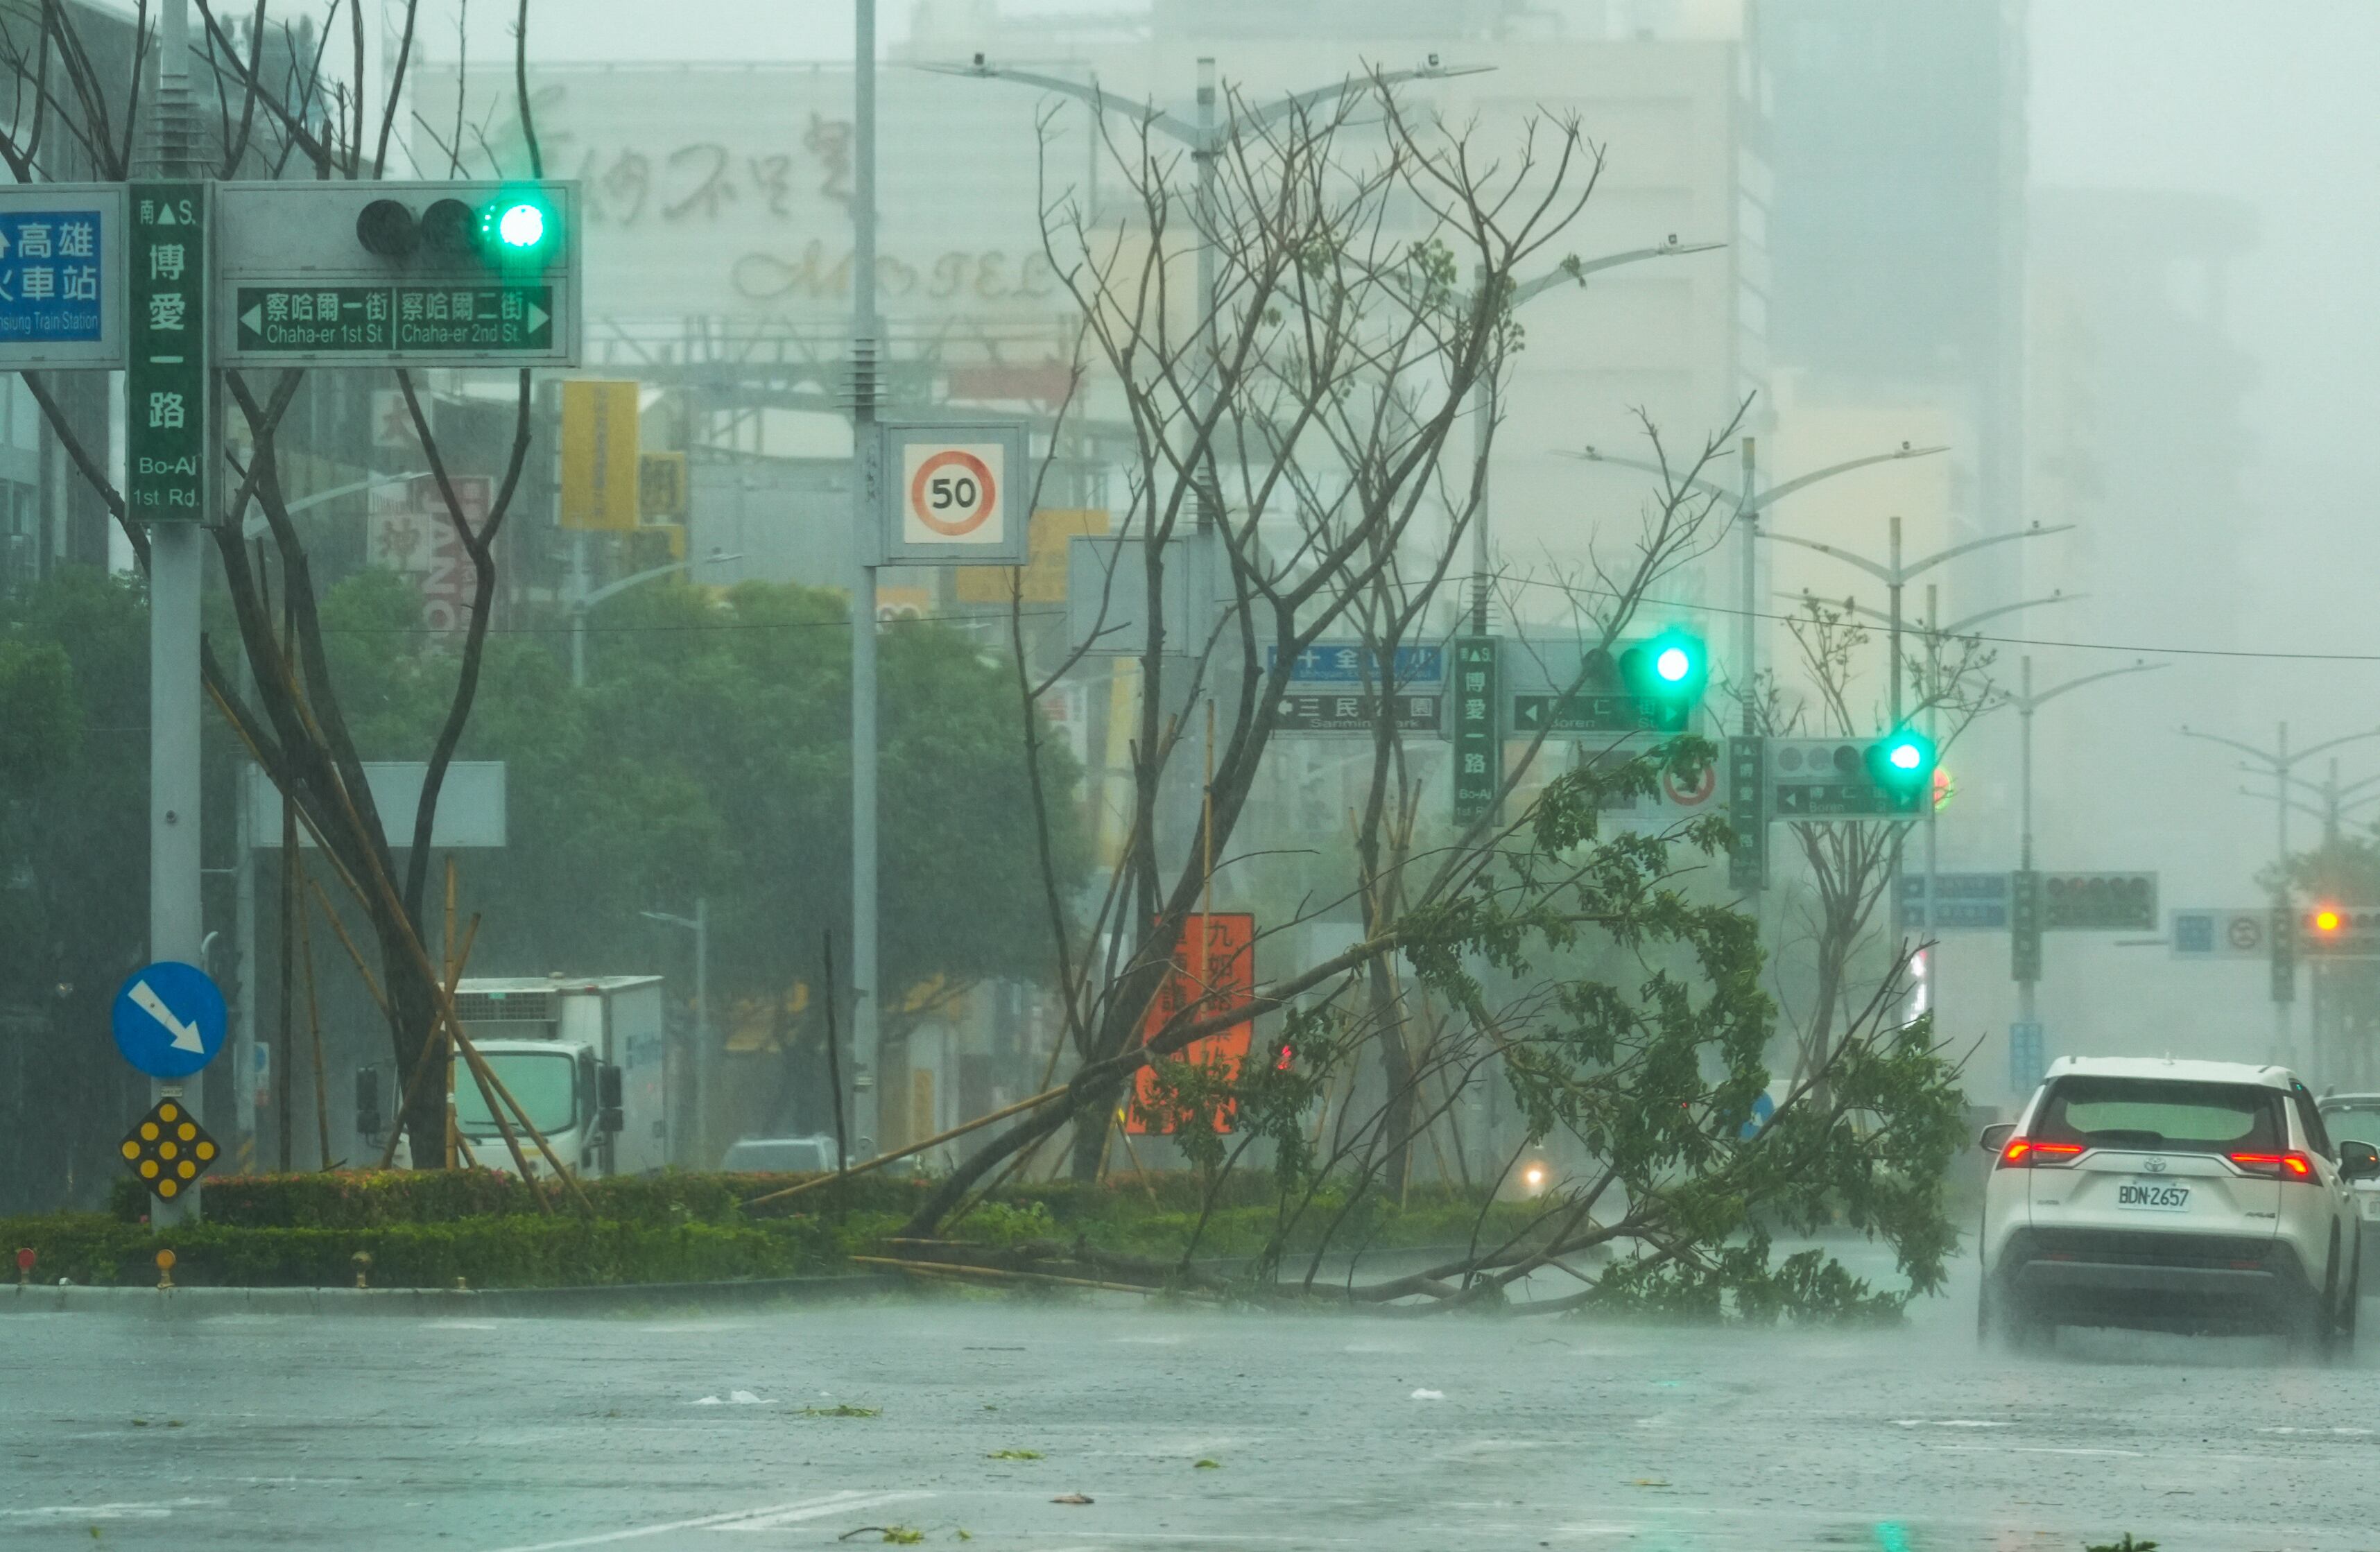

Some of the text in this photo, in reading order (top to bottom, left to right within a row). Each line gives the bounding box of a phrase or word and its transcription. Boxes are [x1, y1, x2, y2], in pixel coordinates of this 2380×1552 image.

[140, 200, 154, 225] 南
[17, 223, 94, 259] 高雄
[266, 292, 388, 322] 察哈爾一街
[402, 291, 523, 321] 察哈爾二街
[33, 311, 60, 329] Train
[62, 311, 98, 330] Station
[402, 323, 468, 343] Chaha-er
[471, 323, 498, 343] 2nd
[149, 244, 186, 429] 博愛一路
[266, 324, 336, 343] Chaha-er
[340, 324, 363, 343] 1st
[134, 488, 200, 508] 1st Rd.
[932, 477, 976, 509] 50
[1395, 719, 1422, 728] ark
[1465, 671, 1486, 774] 博愛一路
[2119, 1185, 2189, 1207] BDN-2657
